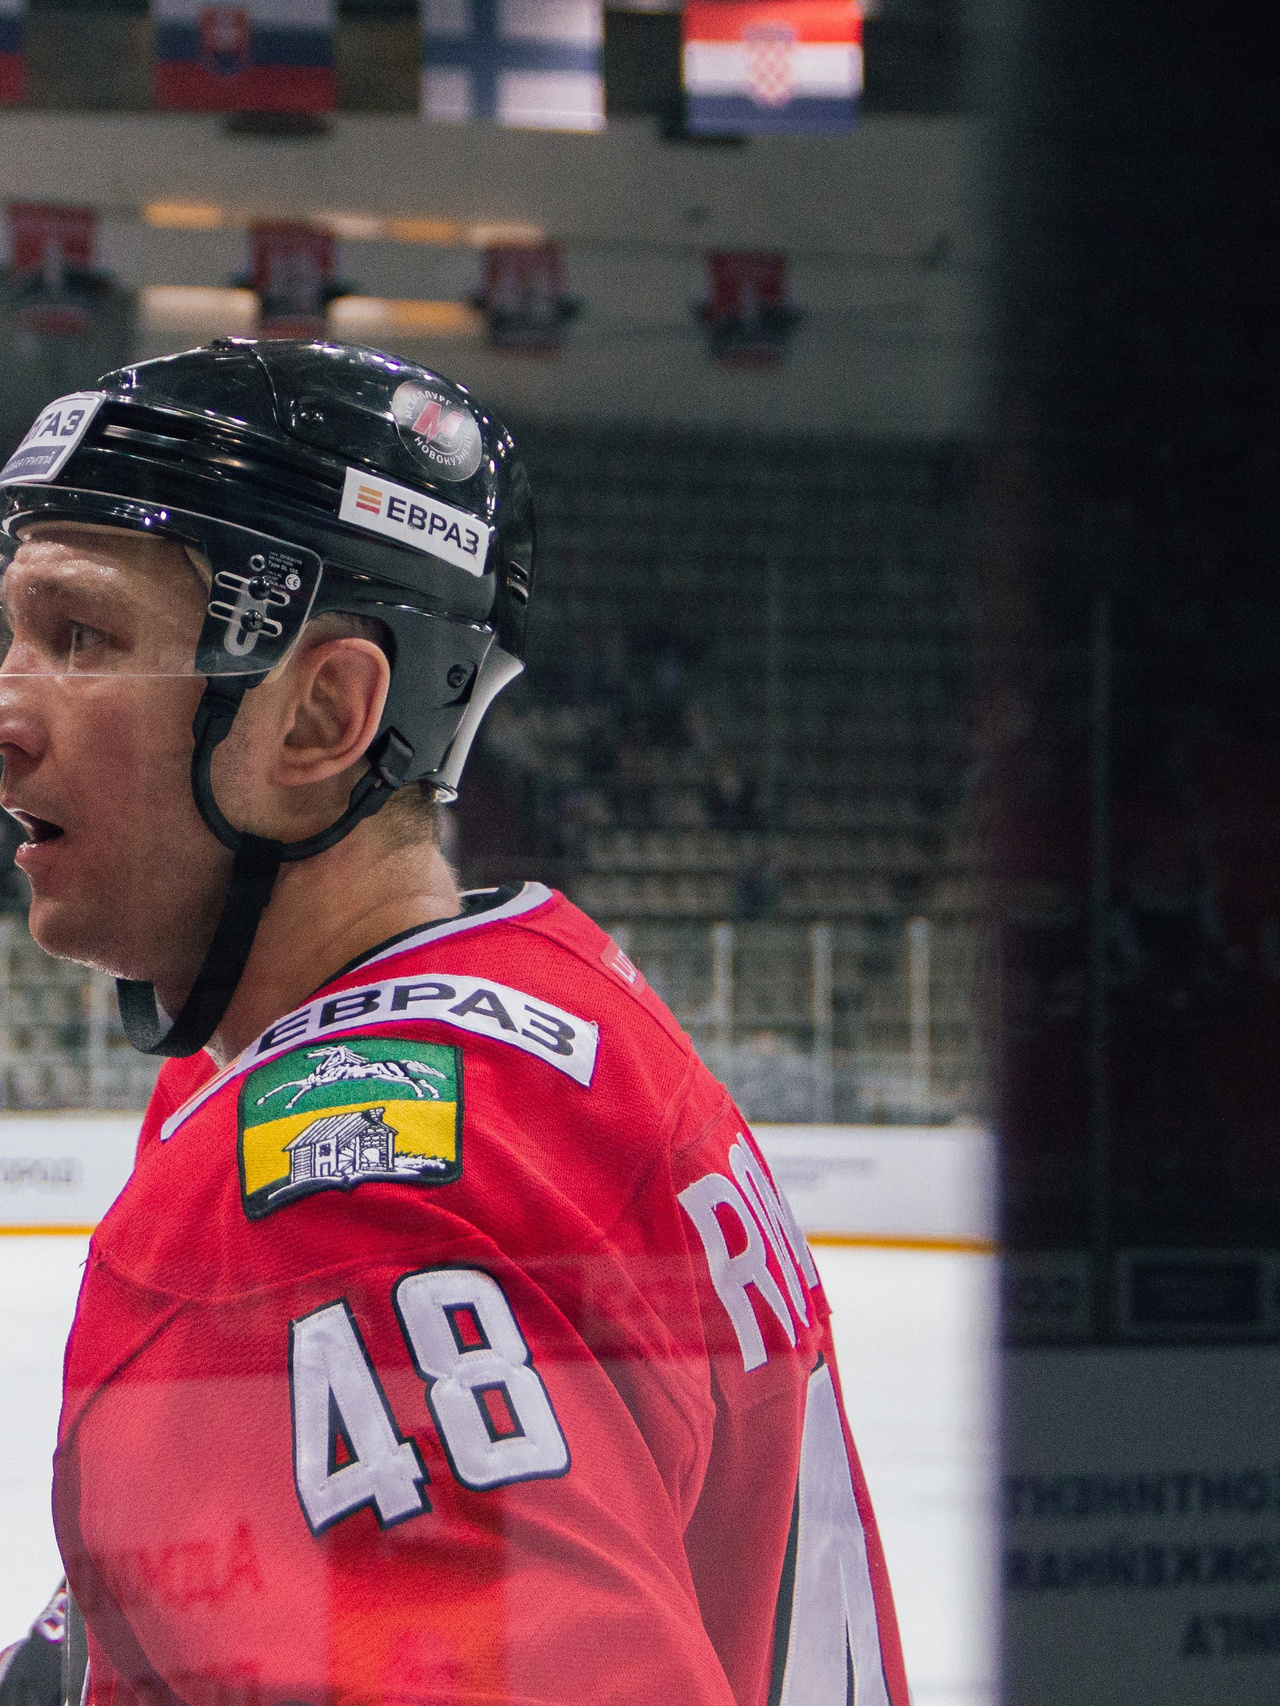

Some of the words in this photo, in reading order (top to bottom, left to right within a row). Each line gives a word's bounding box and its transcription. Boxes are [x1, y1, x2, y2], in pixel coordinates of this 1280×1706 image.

[386, 495, 480, 556] ЕВРАЗ
[256, 982, 577, 1058] ЕВРАЗ
[287, 1264, 572, 1538] 48
